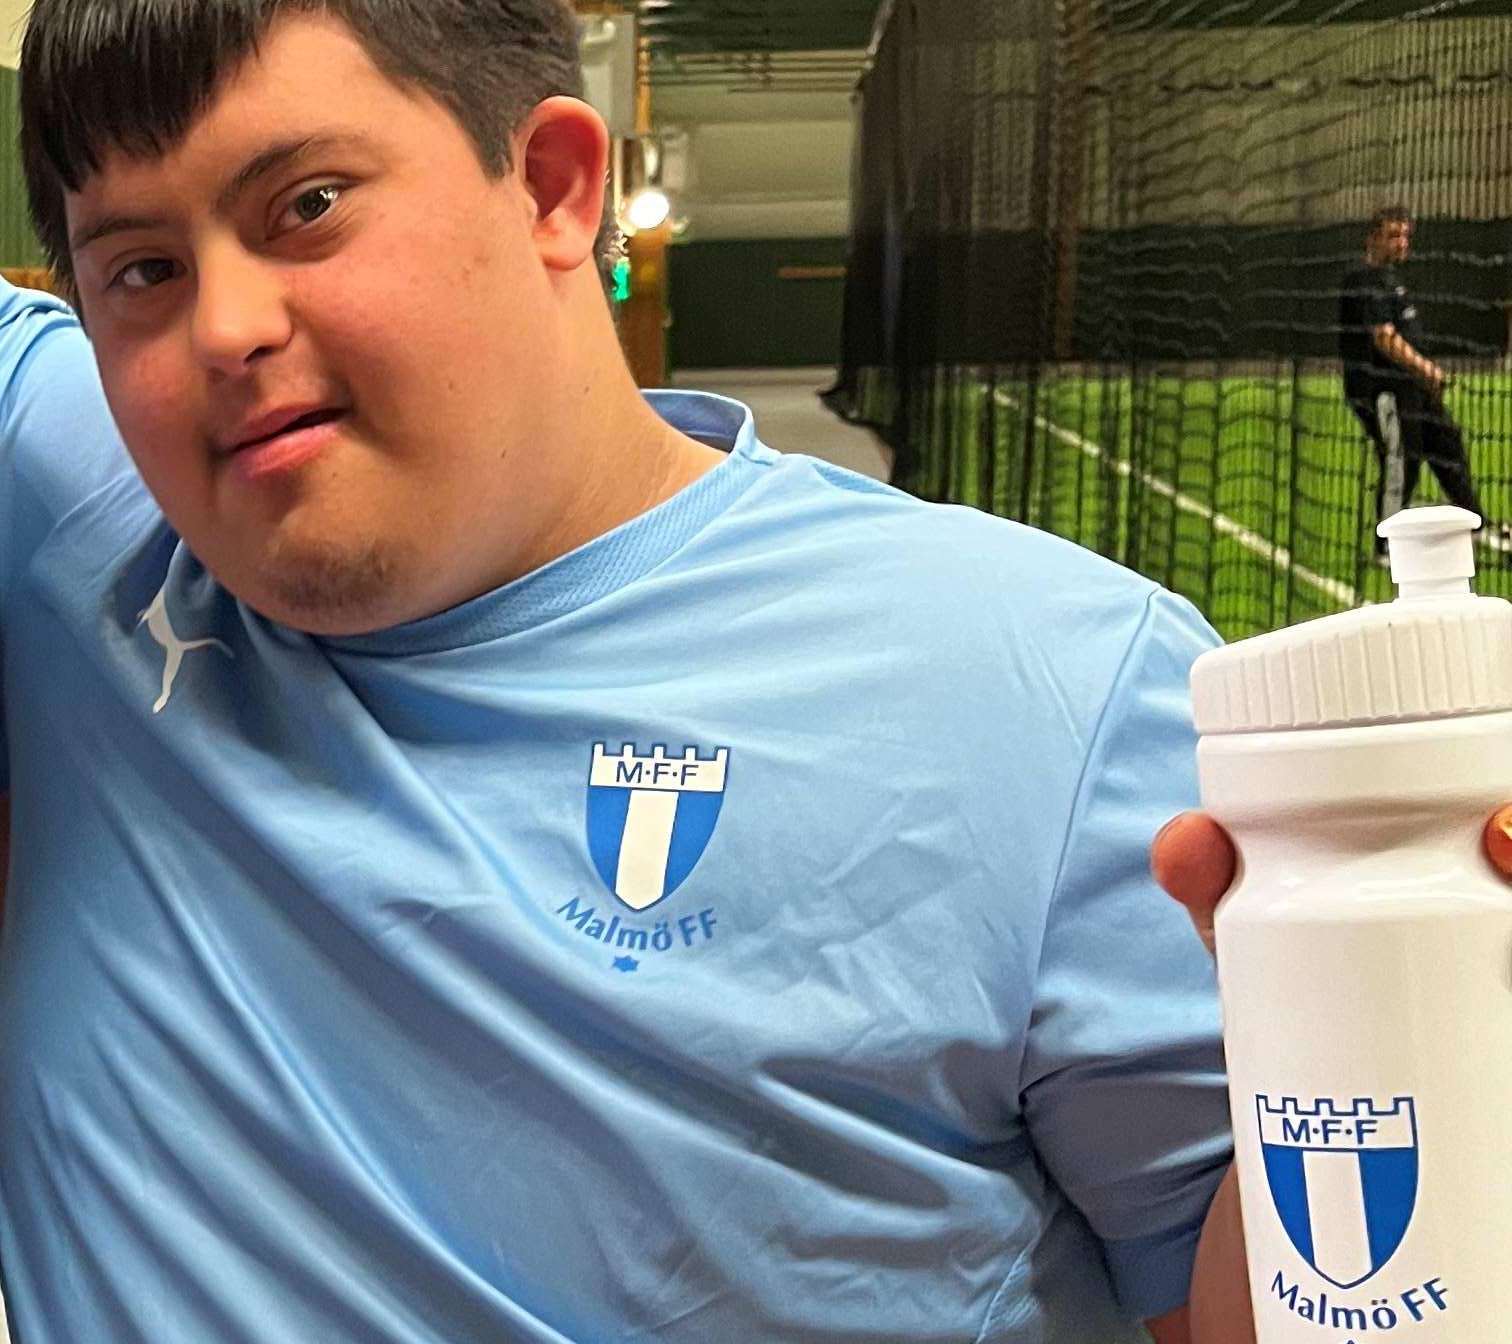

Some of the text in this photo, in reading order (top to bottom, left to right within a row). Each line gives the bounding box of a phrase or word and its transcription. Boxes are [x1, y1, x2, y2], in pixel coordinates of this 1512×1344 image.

[555, 896, 718, 952] Malmö FF
[1271, 1270, 1448, 1330] Malmö FF
